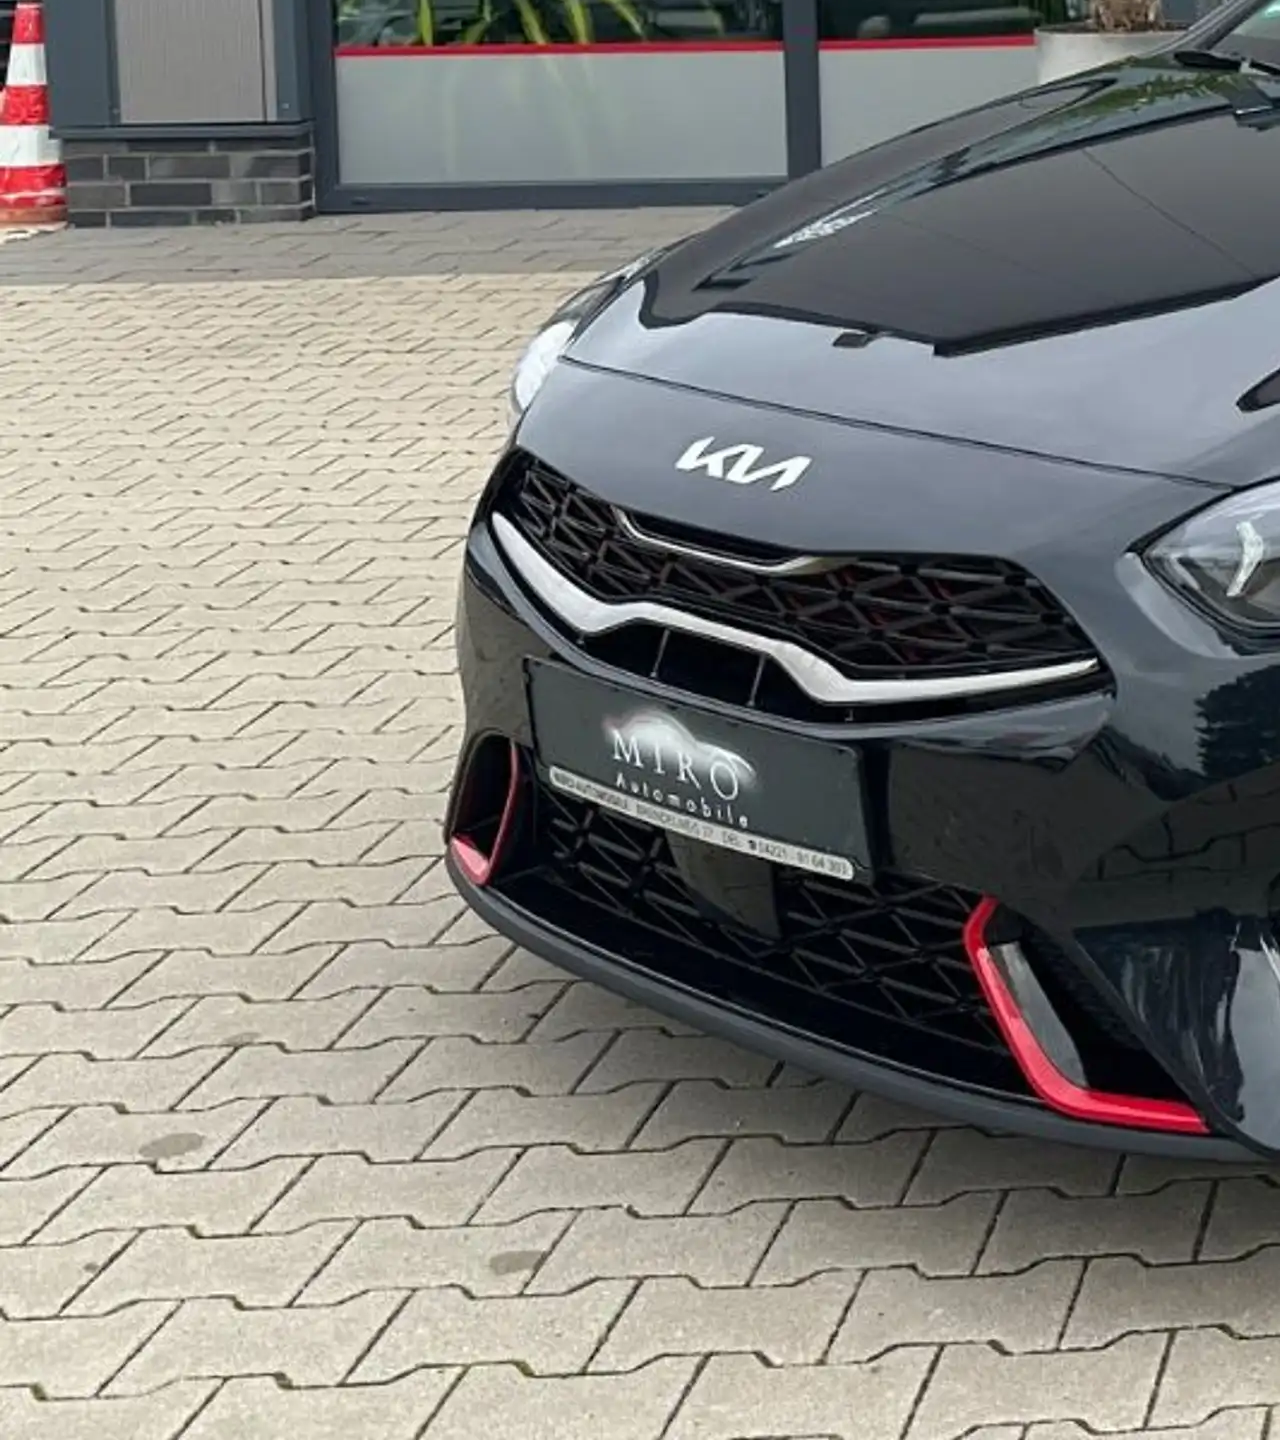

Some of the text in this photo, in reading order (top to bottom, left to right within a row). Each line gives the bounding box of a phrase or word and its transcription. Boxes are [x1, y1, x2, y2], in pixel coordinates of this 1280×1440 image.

[674, 435, 813, 491] KIA
[612, 728, 739, 801] MIRO
[615, 772, 748, 829] Automobile
